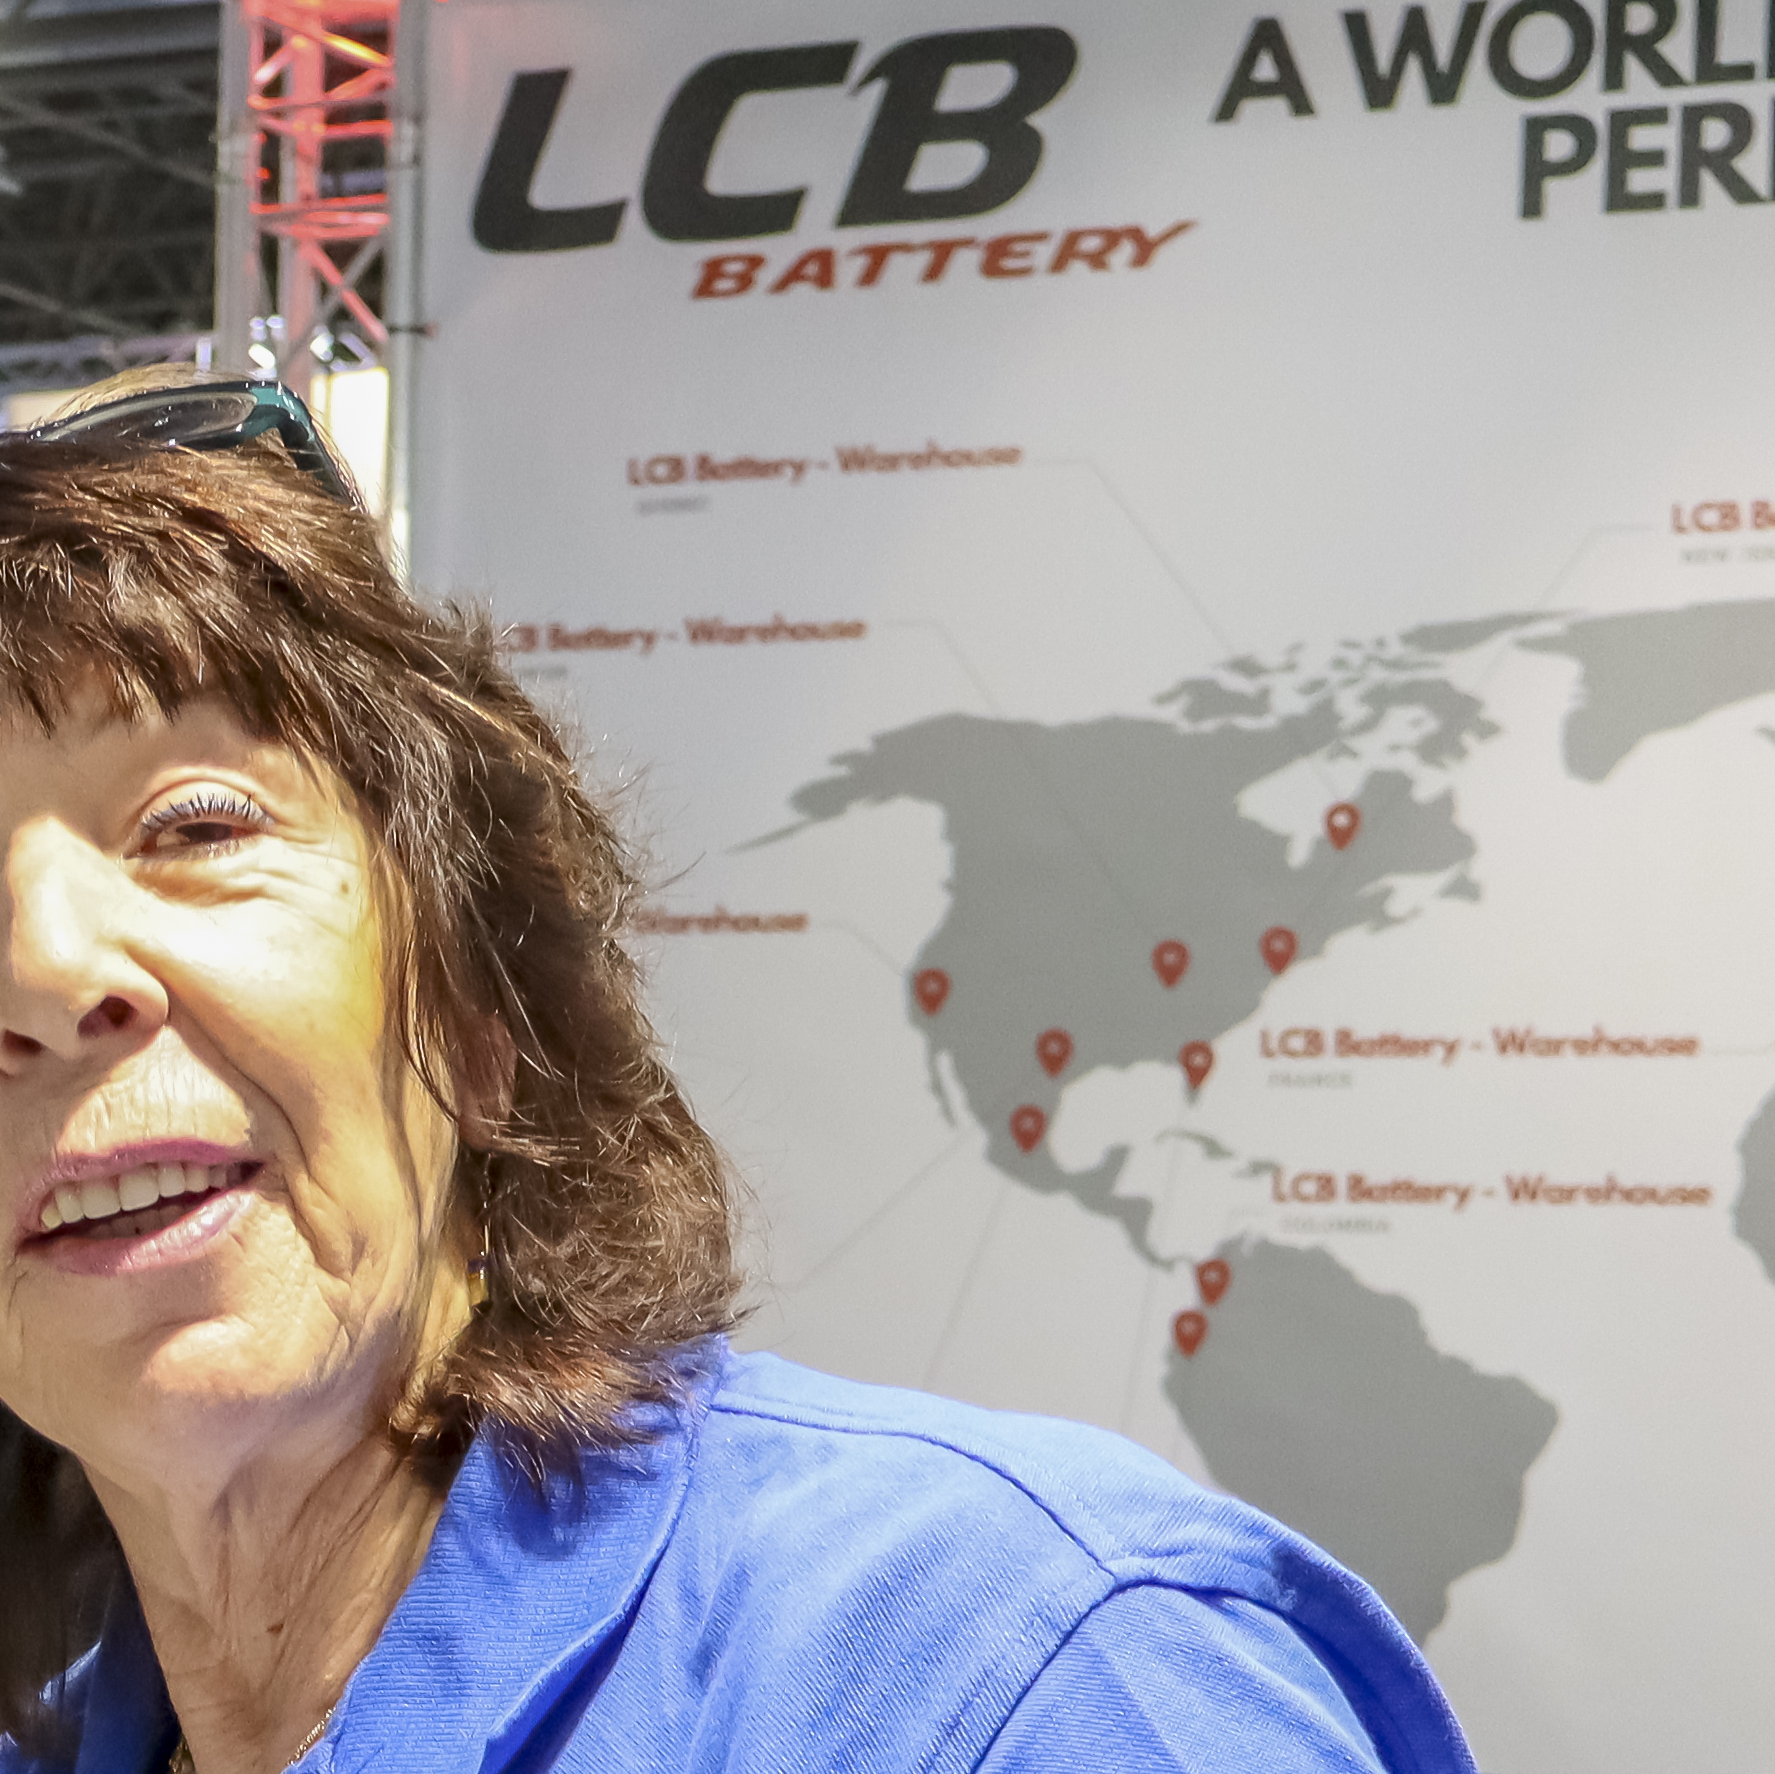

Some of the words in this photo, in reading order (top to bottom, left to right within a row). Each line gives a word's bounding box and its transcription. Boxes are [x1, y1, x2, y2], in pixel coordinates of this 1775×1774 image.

[1210, 16, 1317, 123] A
[1342, 0, 1775, 112] WORL
[472, 25, 1079, 254] LCB
[1518, 97, 1775, 219] PER
[691, 219, 1199, 300] BATTERY
[625, 454, 685, 486] LCB
[694, 452, 807, 487] Battery
[835, 438, 1025, 474] Warehouse
[684, 612, 867, 646] Warehouse
[1260, 1027, 1324, 1058] LCB
[1335, 1027, 1459, 1067] Battery
[1492, 1024, 1701, 1057] Warehouse
[1272, 1169, 1337, 1203] LCB
[1347, 1173, 1474, 1213] Battery
[1504, 1173, 1713, 1206] Warehouse
